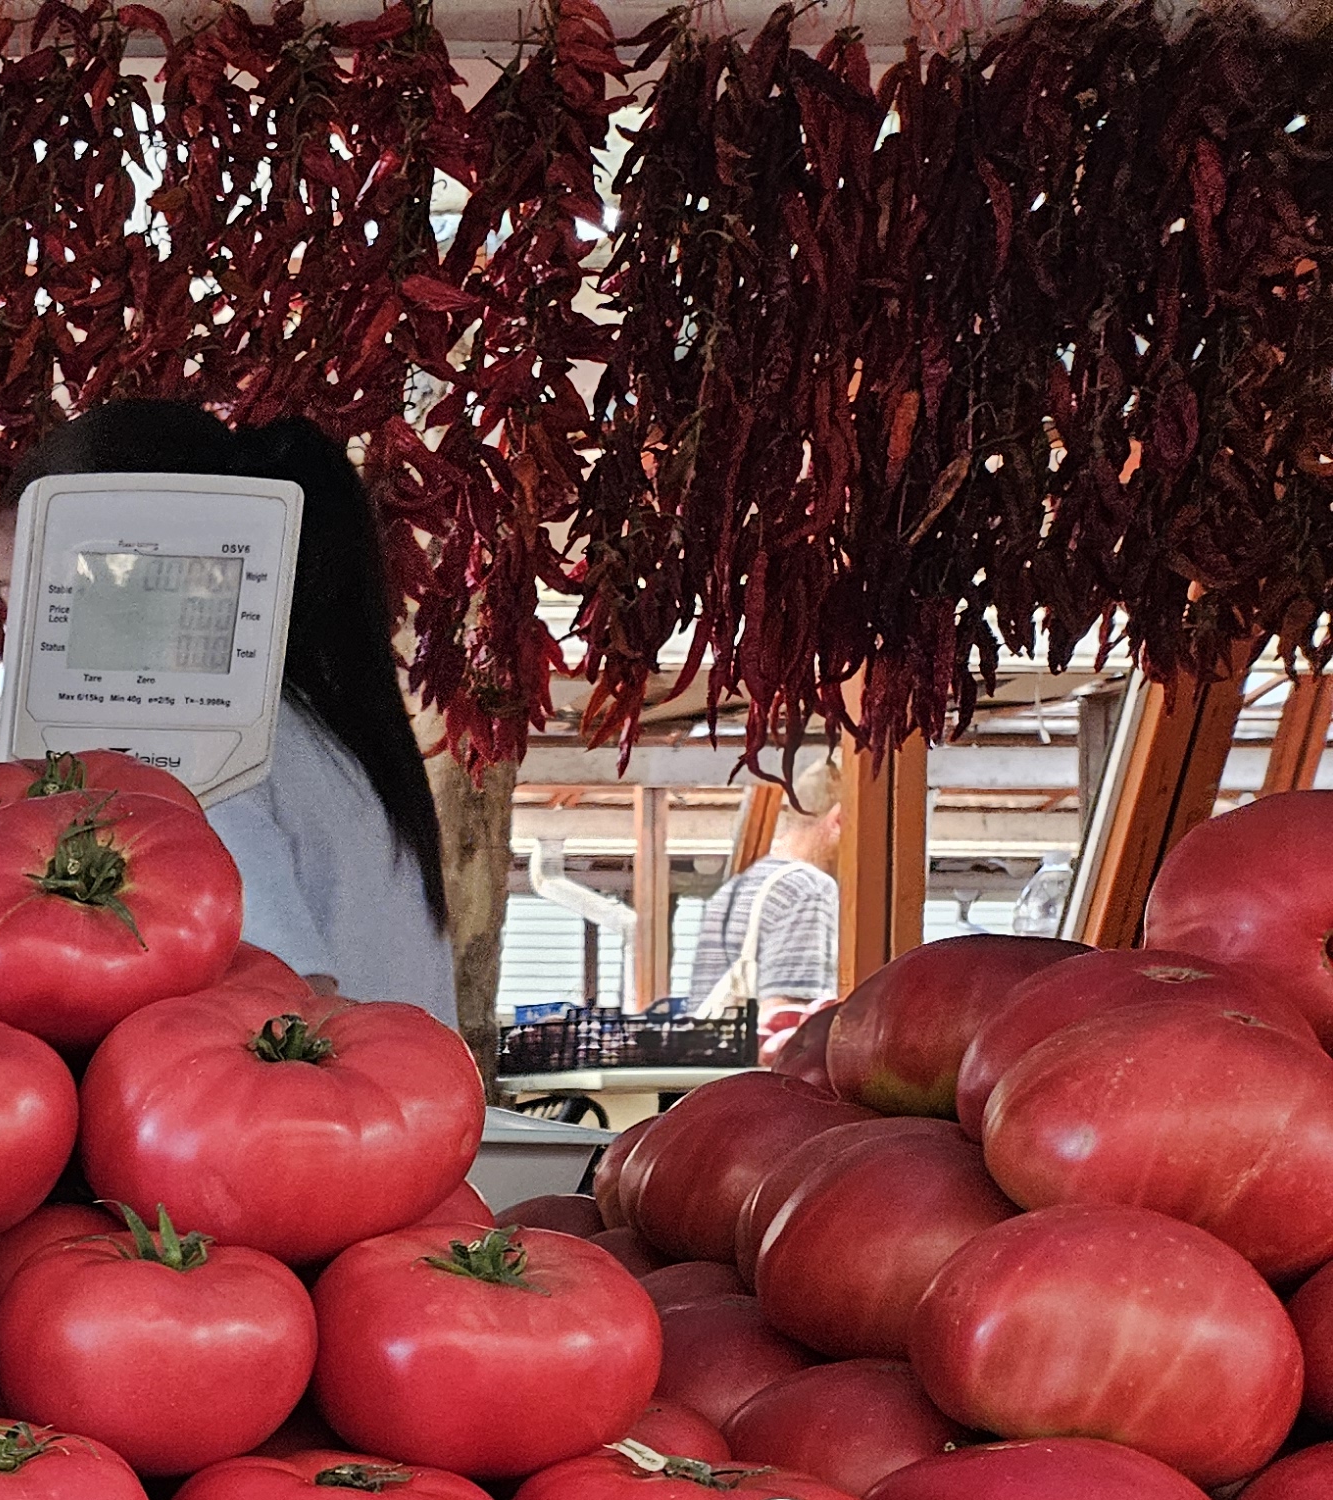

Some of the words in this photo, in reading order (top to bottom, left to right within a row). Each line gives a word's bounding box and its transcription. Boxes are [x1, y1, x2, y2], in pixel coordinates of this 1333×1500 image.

[48, 584, 73, 594] Stable
[49, 605, 70, 613] Price
[48, 614, 68, 623] Lock
[240, 612, 261, 621] Price
[40, 641, 66, 651] Status
[236, 649, 256, 658] Total
[83, 673, 102, 682] Tare
[136, 675, 156, 684] Zero
[58, 693, 75, 701] Max
[110, 694, 125, 702] Min
[135, 752, 181, 767] aisy
